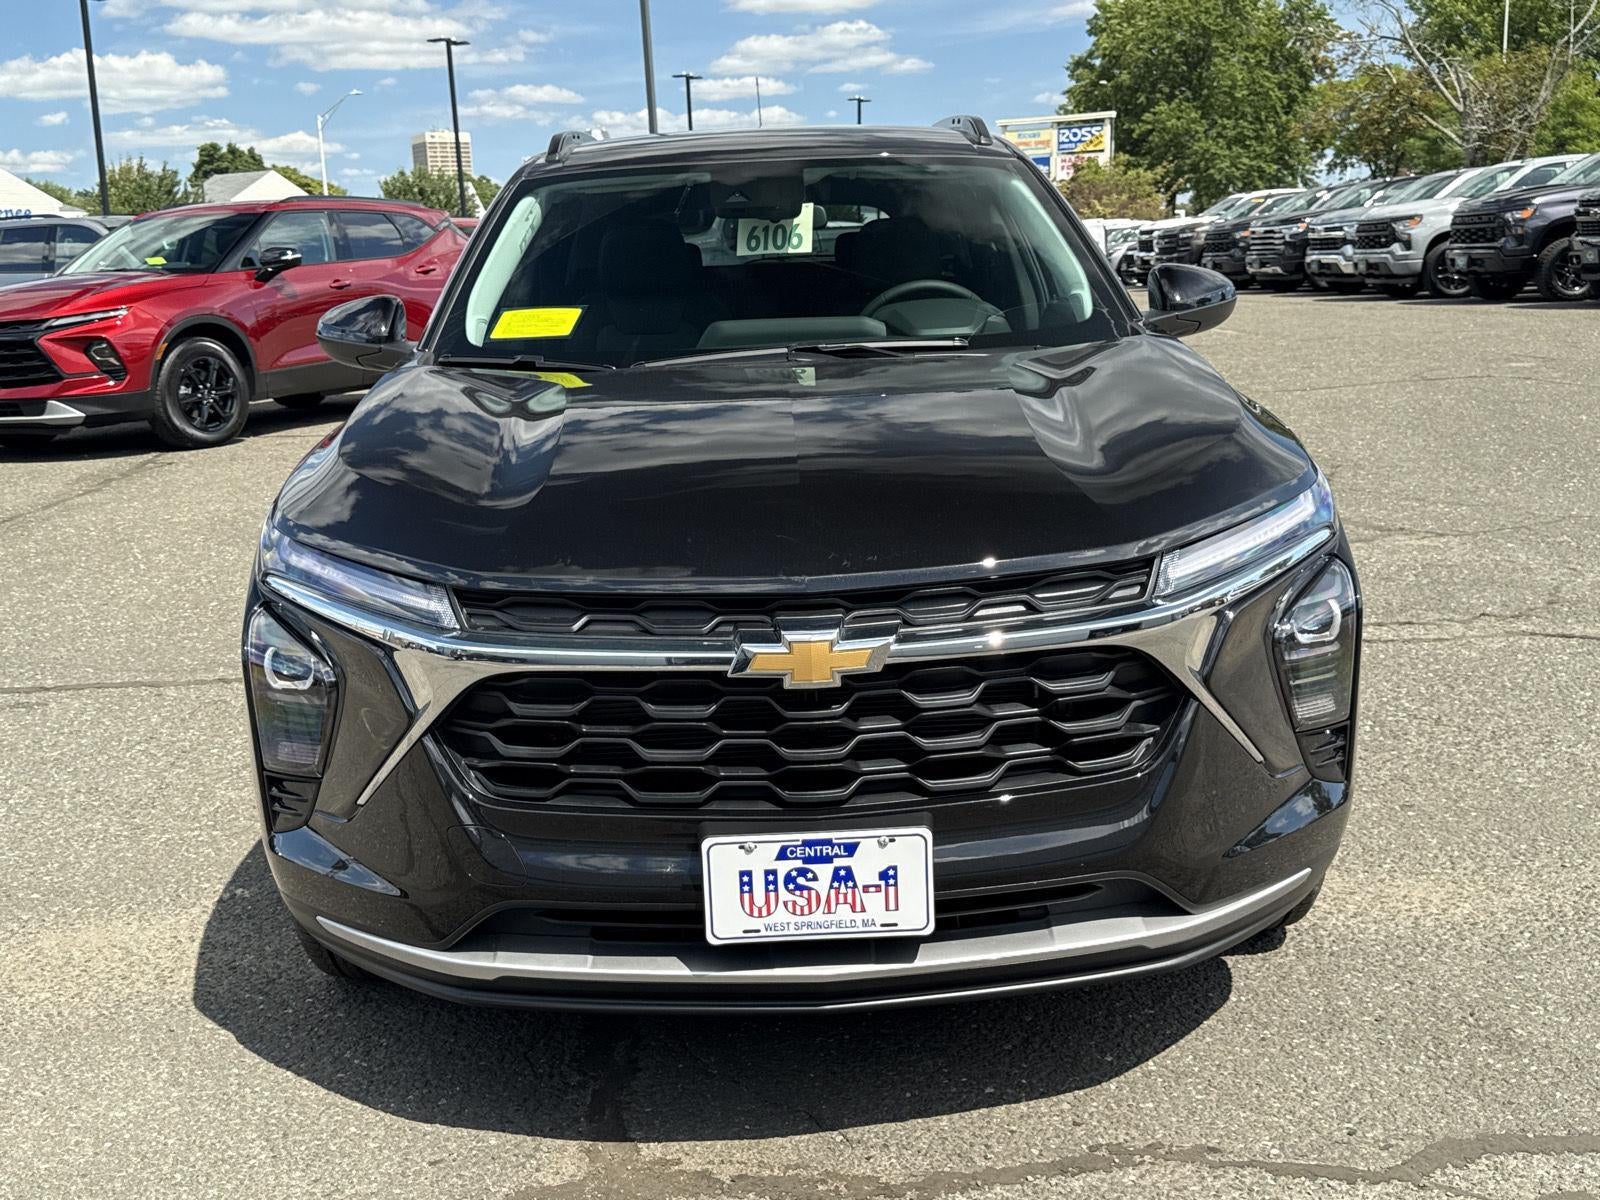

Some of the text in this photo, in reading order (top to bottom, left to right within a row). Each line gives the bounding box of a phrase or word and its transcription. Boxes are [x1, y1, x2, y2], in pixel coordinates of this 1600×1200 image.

[1059, 126, 1102, 142] ROSS
[746, 223, 803, 252] 6106
[786, 844, 848, 858] CENTRAL
[738, 865, 899, 918] USA-1
[764, 918, 877, 932] WEST SPRINGFIELD, MA
